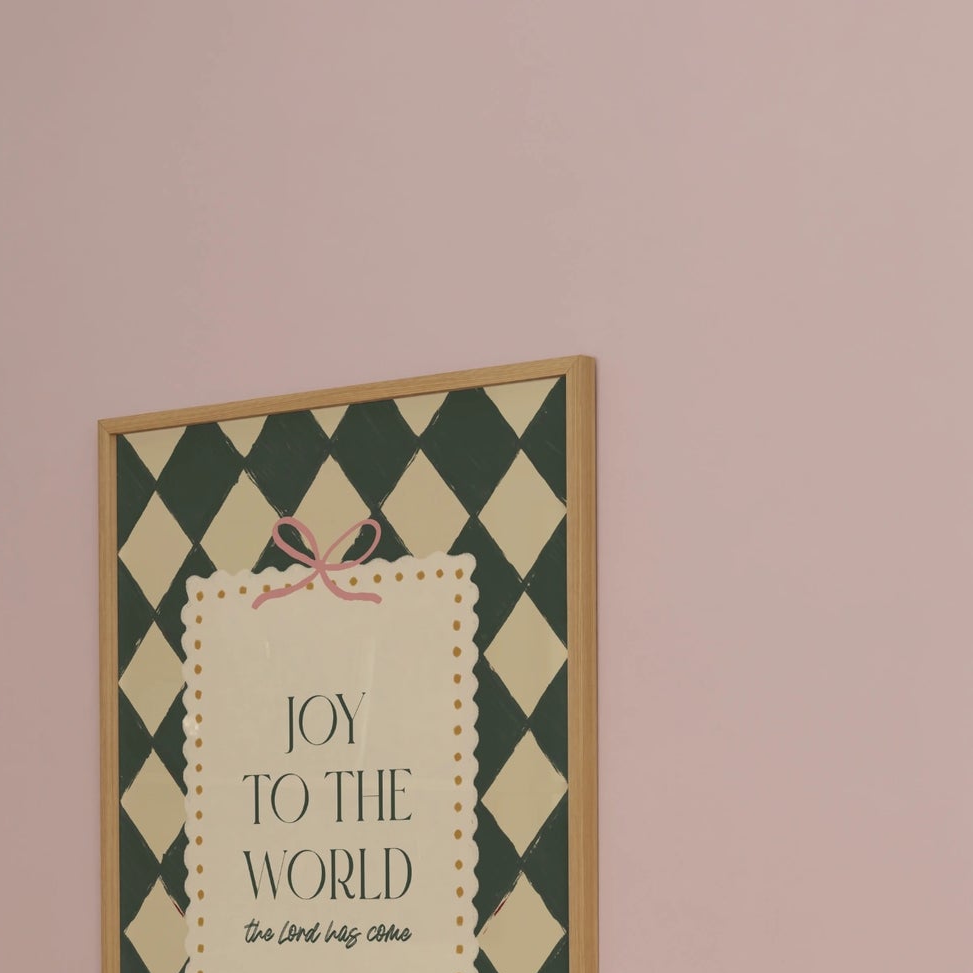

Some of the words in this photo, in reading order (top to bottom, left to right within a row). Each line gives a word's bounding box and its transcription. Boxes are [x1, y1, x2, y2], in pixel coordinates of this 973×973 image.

[284, 691, 367, 755] JOY
[241, 771, 310, 825] TO
[323, 768, 413, 823] THE
[242, 847, 413, 901] WORLD
[243, 917, 275, 944] the
[324, 919, 362, 950] has
[366, 922, 414, 943] come
